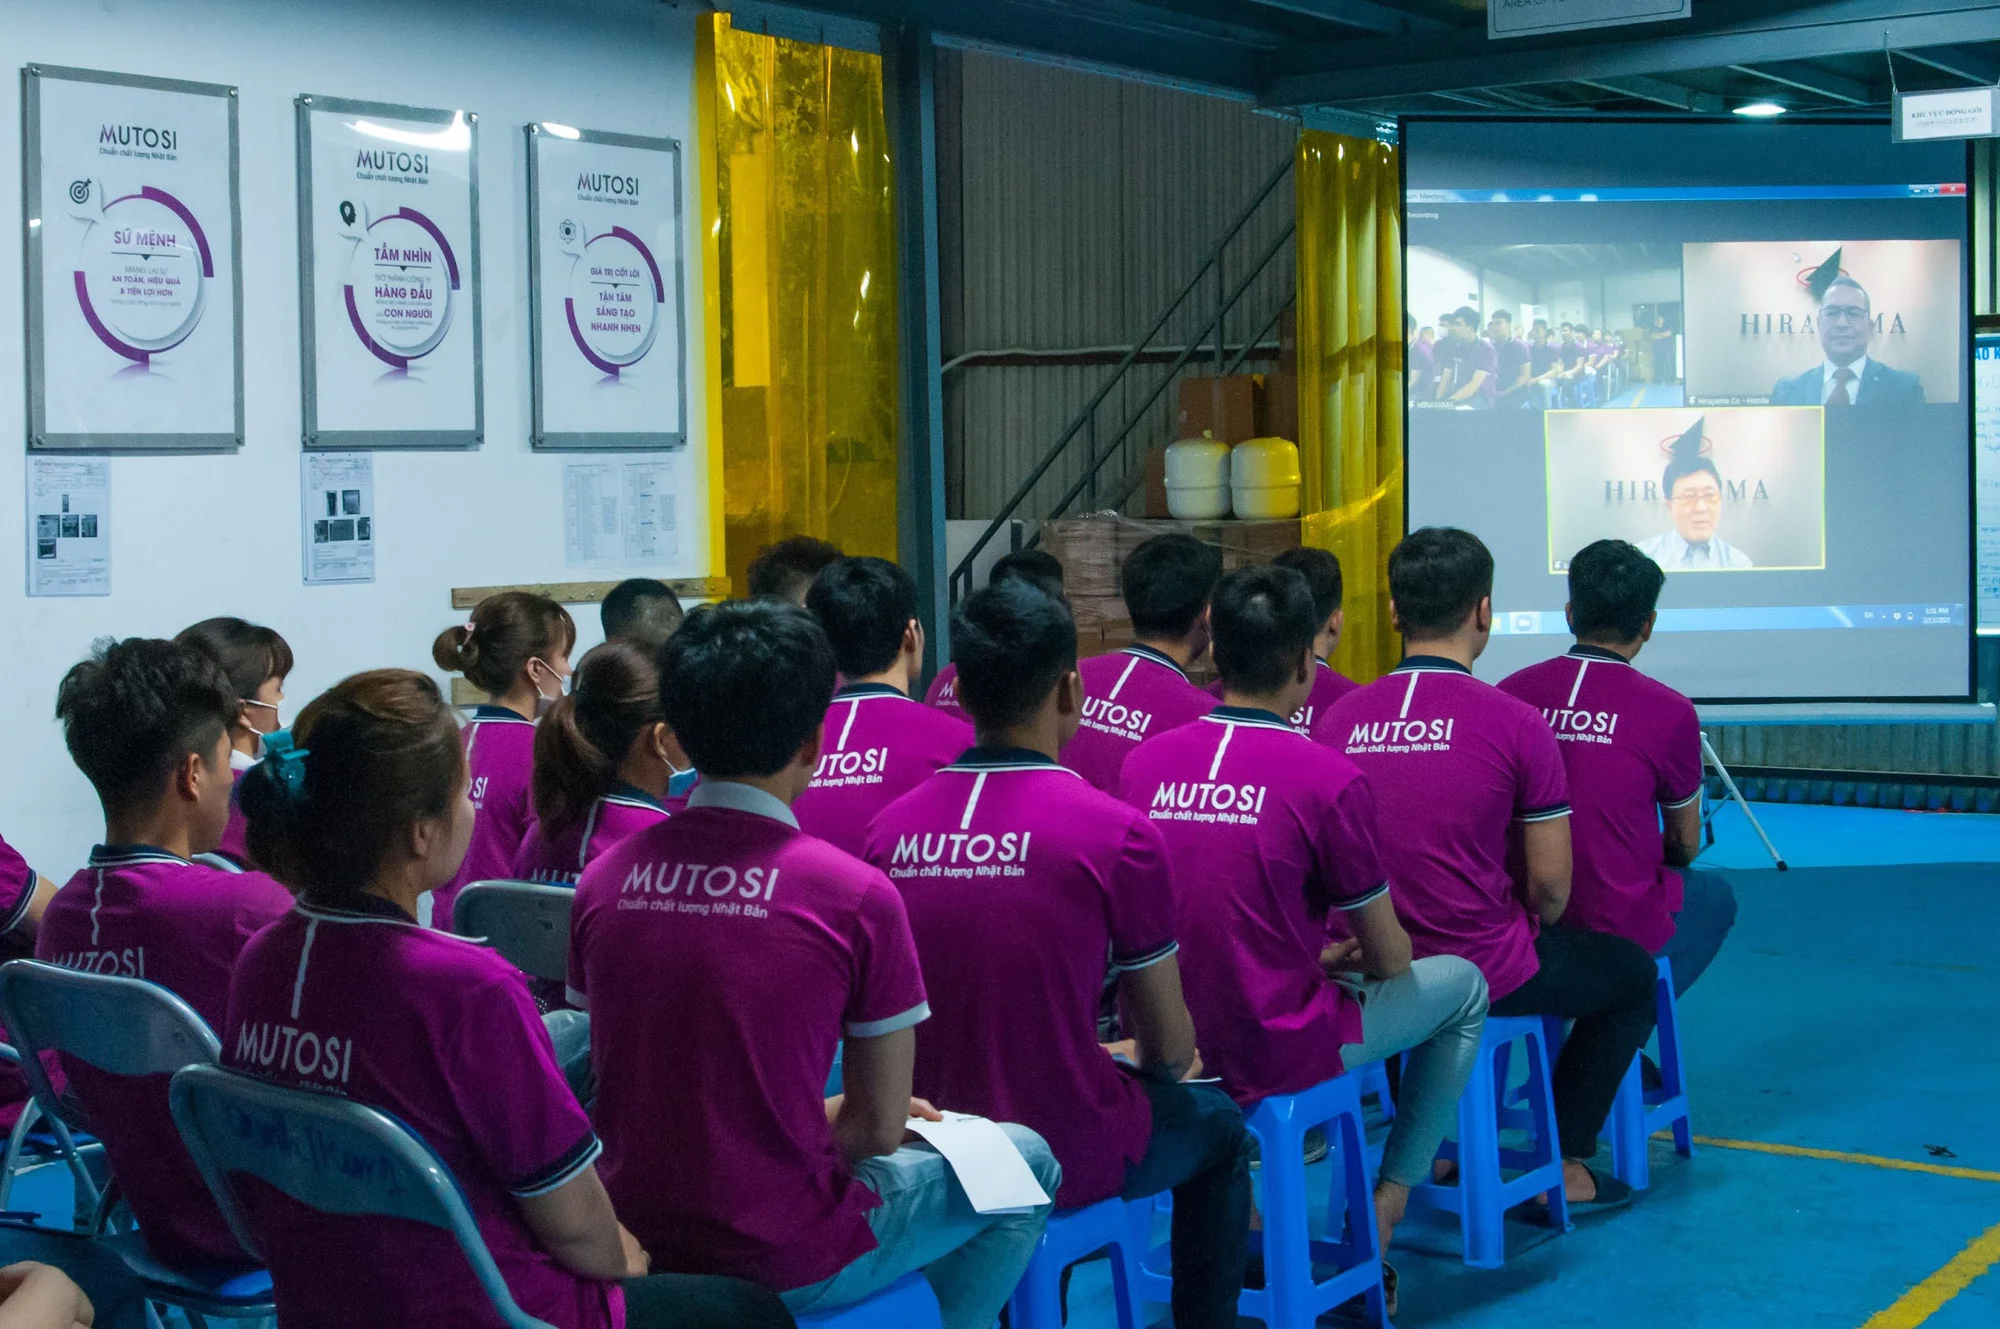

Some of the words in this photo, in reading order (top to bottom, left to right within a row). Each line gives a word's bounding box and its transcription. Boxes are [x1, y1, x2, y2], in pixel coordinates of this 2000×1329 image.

[99, 123, 177, 150] MUTOSI
[356, 149, 429, 174] MUTOSI
[577, 172, 639, 196] MUTOSI
[113, 227, 132, 245] SỨ
[136, 229, 176, 250] MỆNH
[374, 241, 399, 261] TẦM
[403, 247, 432, 263] NHÌN
[590, 266, 602, 276] GIÁ
[375, 283, 407, 299] HÀNG
[410, 283, 432, 300] ĐẦU
[599, 290, 614, 304] TẬN
[615, 291, 632, 303] TÂM
[384, 308, 403, 318] CON
[406, 308, 432, 319] NGƯỜI
[596, 304, 618, 317] SÁNG
[590, 322, 619, 331] NHANH
[620, 323, 641, 335] NHẸN
[1740, 312, 1906, 335] HIRAMA
[1603, 479, 1769, 502] HIRMA
[1081, 696, 1152, 733] UTOSI
[1540, 708, 1618, 735] UTOSI
[1348, 718, 1454, 745] MUTOSI
[812, 747, 888, 778] UTOSI
[1151, 781, 1267, 814] MUTOSI
[891, 831, 1031, 864] MUTOSI
[621, 862, 779, 901] MUTOSI
[889, 864, 918, 878] Chuẩn
[919, 864, 942, 877] chất
[943, 866, 973, 879] lượng
[975, 864, 1002, 878] Nhật
[1003, 864, 1025, 877] Bản
[617, 895, 648, 911] Chuẩn
[650, 899, 675, 912] chất
[677, 901, 710, 917] lượng
[712, 902, 740, 916] Nhật
[743, 903, 768, 919] Bản
[235, 1020, 352, 1083] MUTOSI
